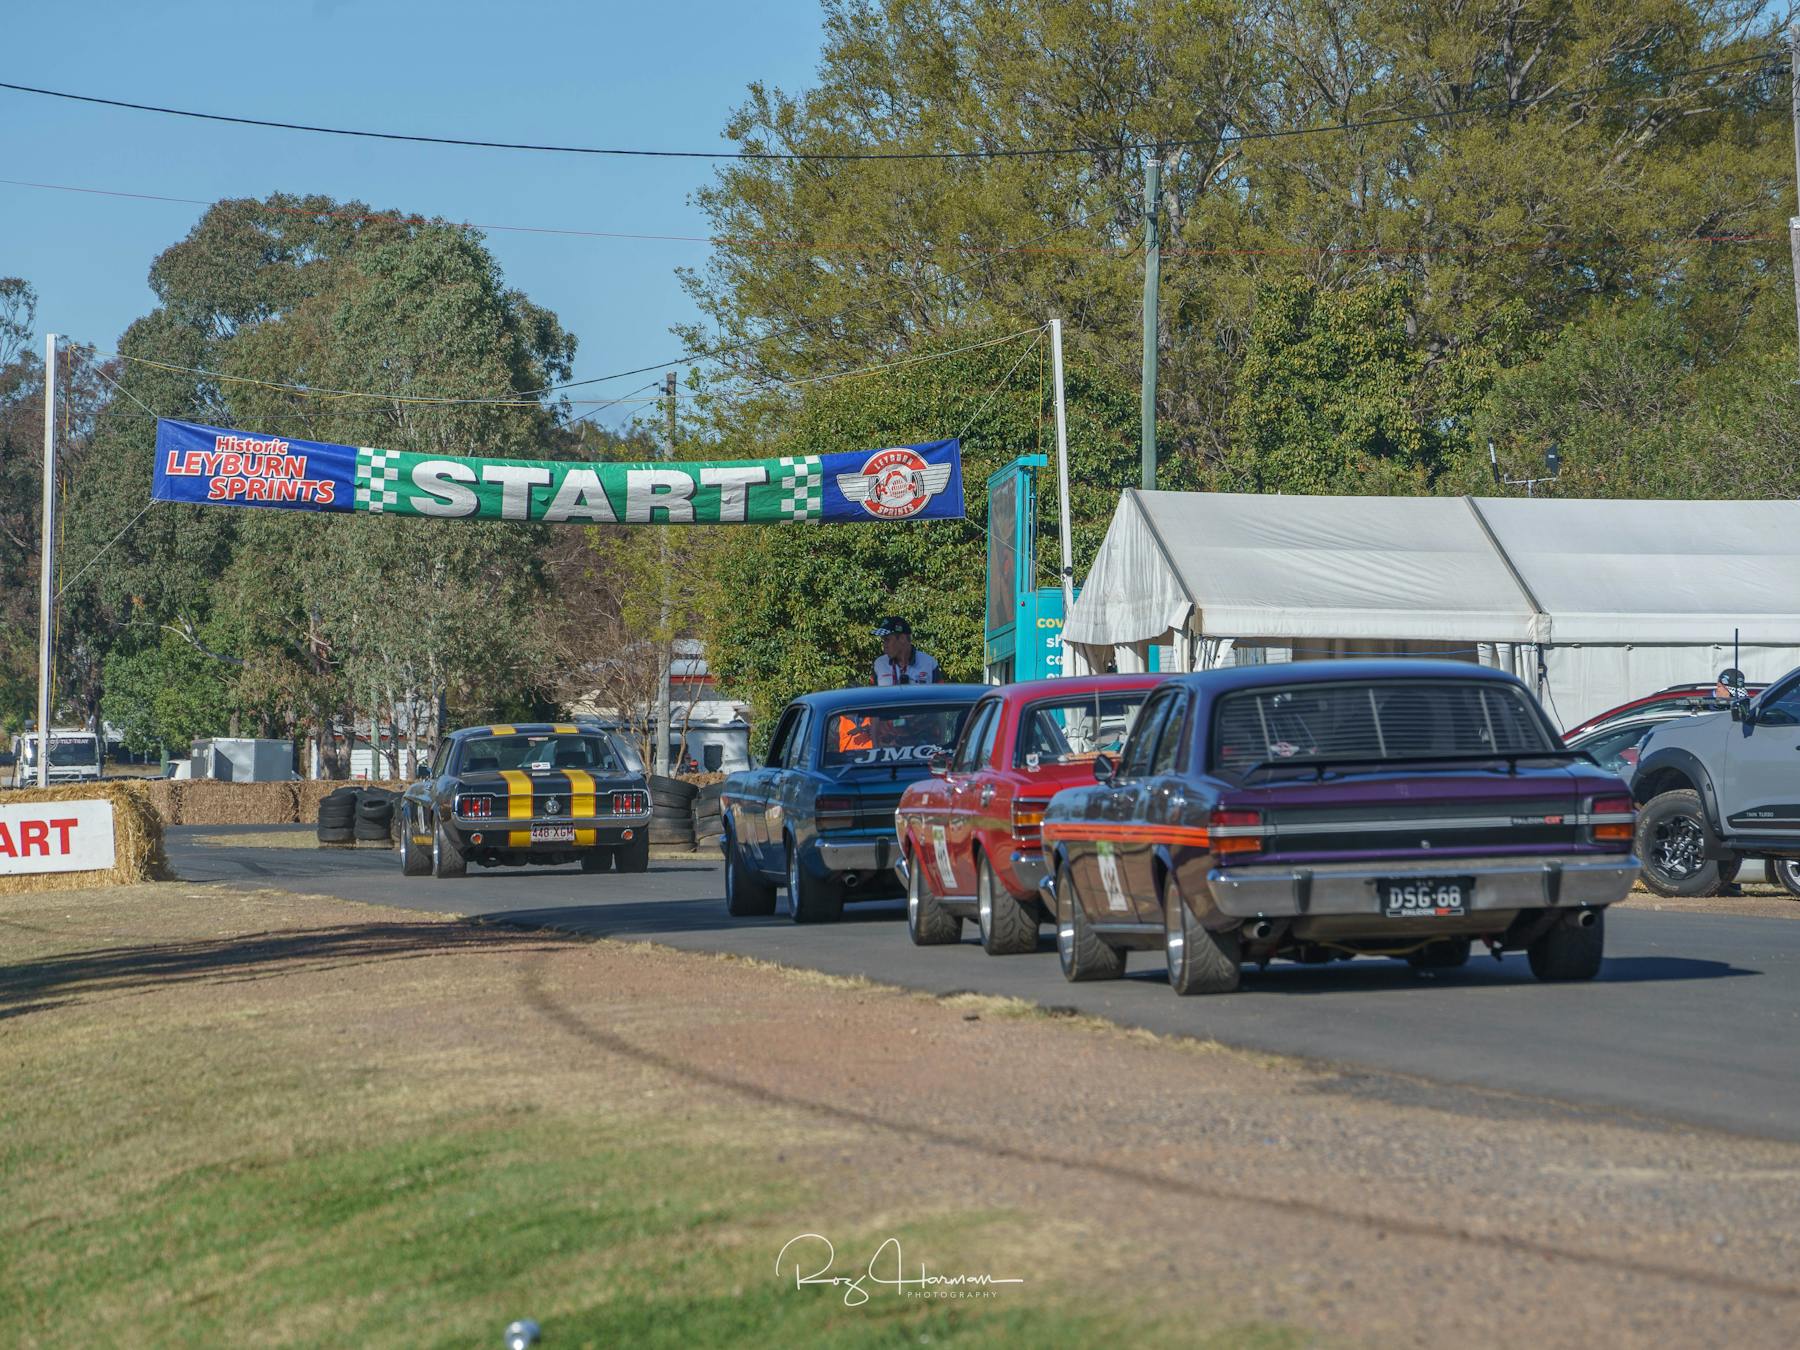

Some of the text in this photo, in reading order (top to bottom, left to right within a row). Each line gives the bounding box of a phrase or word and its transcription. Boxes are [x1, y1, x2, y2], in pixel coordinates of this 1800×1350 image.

[215, 435, 289, 455] Historic
[165, 449, 307, 479] LEYBURN
[874, 453, 914, 470] LEYBURN
[208, 477, 336, 504] SPRINTS
[411, 460, 769, 522] START
[877, 503, 915, 517] SPRINTS
[854, 744, 934, 764] JMC
